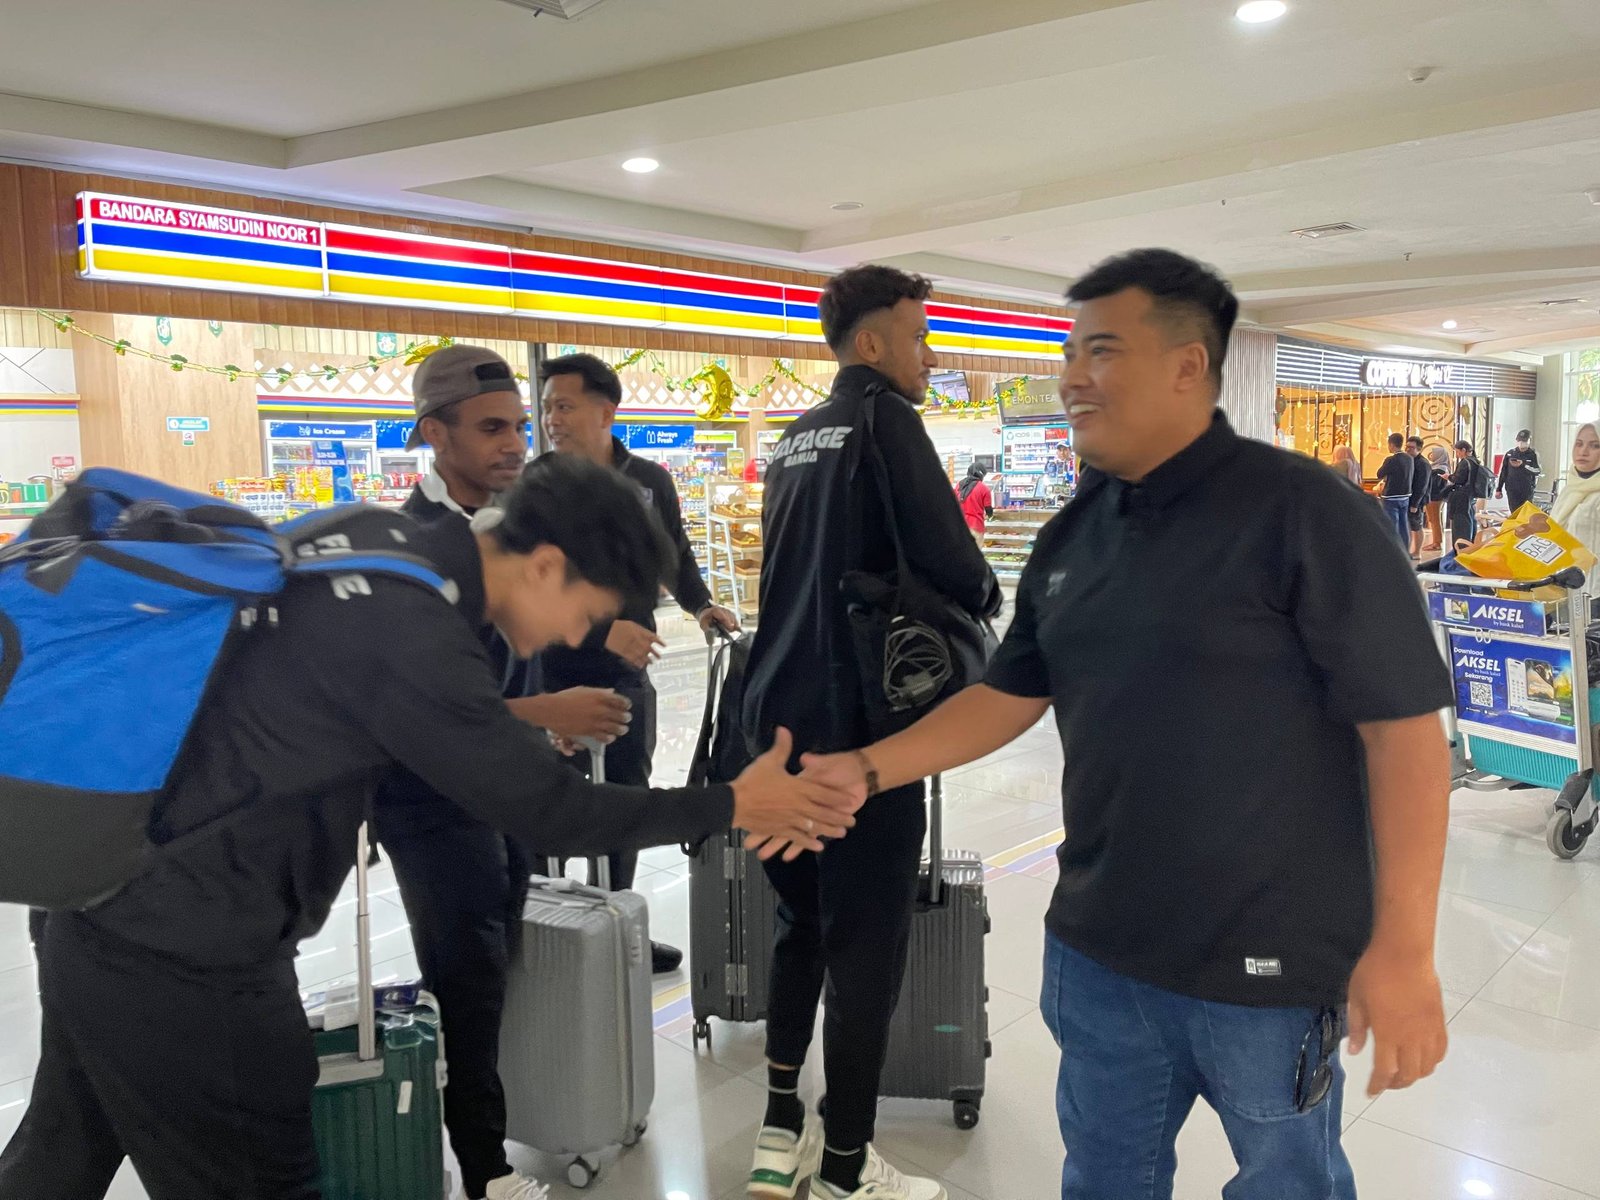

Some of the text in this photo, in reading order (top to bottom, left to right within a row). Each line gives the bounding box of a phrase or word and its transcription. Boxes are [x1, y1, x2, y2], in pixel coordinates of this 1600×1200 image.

[99, 200, 318, 243] BANDARA SYAMSUDIN NOOR 1
[1012, 395, 1038, 404] EMON
[774, 426, 853, 460] AFAGE
[1472, 604, 1524, 623] AKSEL
[1453, 646, 1484, 656] Download
[1456, 655, 1501, 671] AKSEL
[1464, 671, 1493, 683] Sekarang
